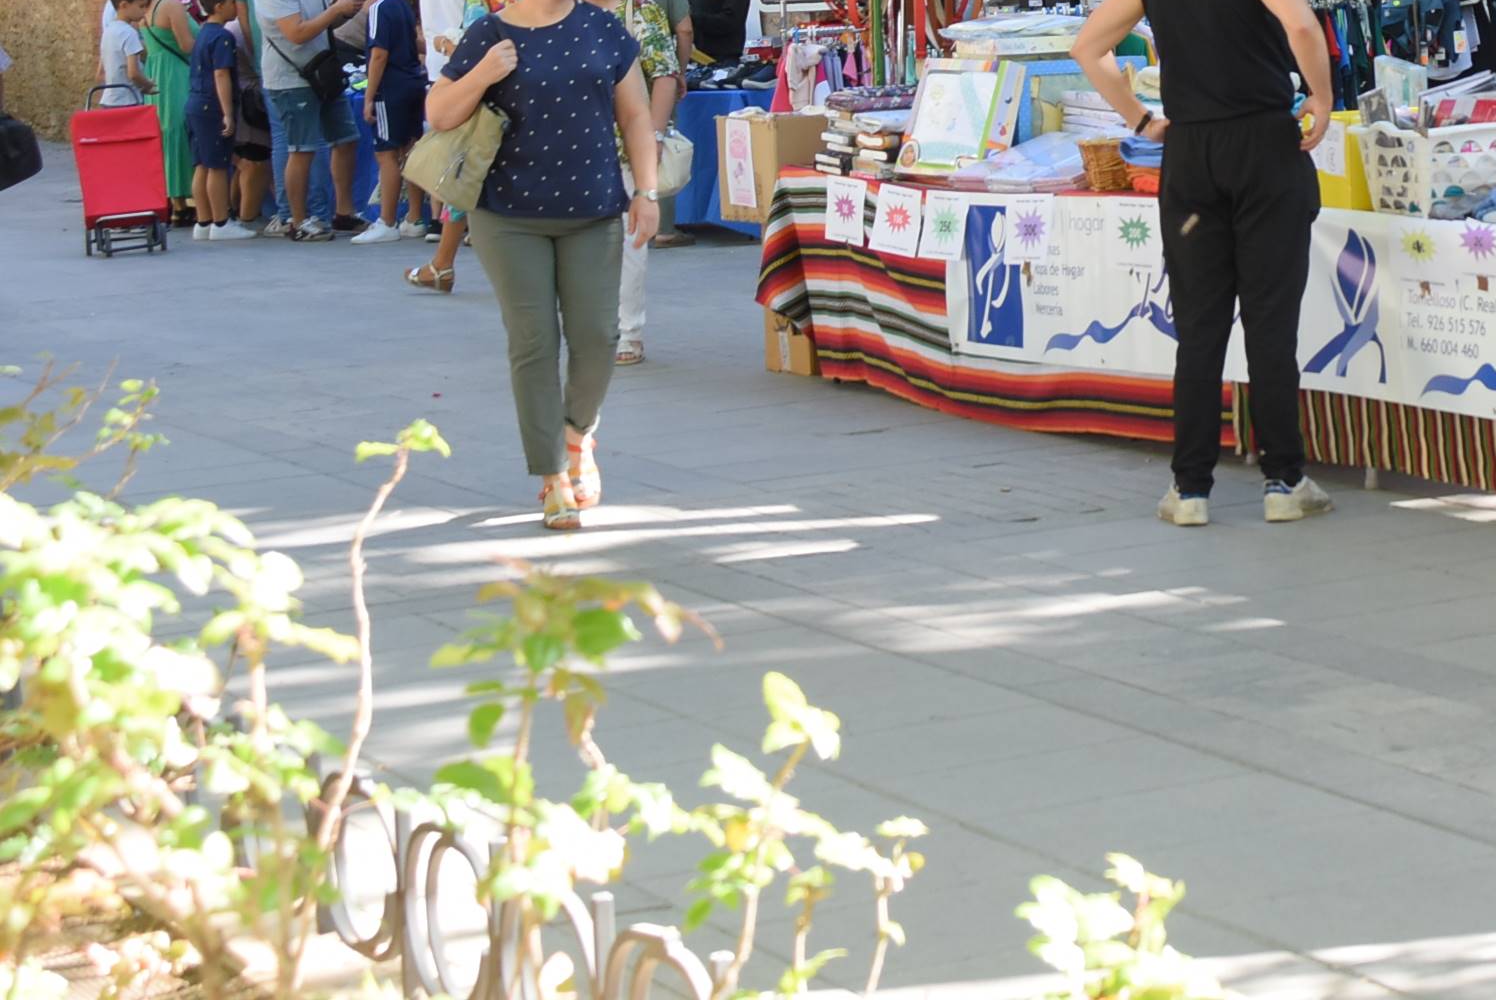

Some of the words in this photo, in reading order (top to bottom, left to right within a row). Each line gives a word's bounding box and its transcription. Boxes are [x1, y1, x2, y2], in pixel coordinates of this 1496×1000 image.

[1069, 210, 1105, 236] hogar
[1406, 312, 1423, 329] Tel.
[1428, 314, 1445, 332] 926
[1448, 316, 1466, 333] 515
[1469, 319, 1487, 337] 576
[1420, 337, 1438, 354] 660
[1441, 340, 1459, 356] 004
[1461, 343, 1480, 360] 460
